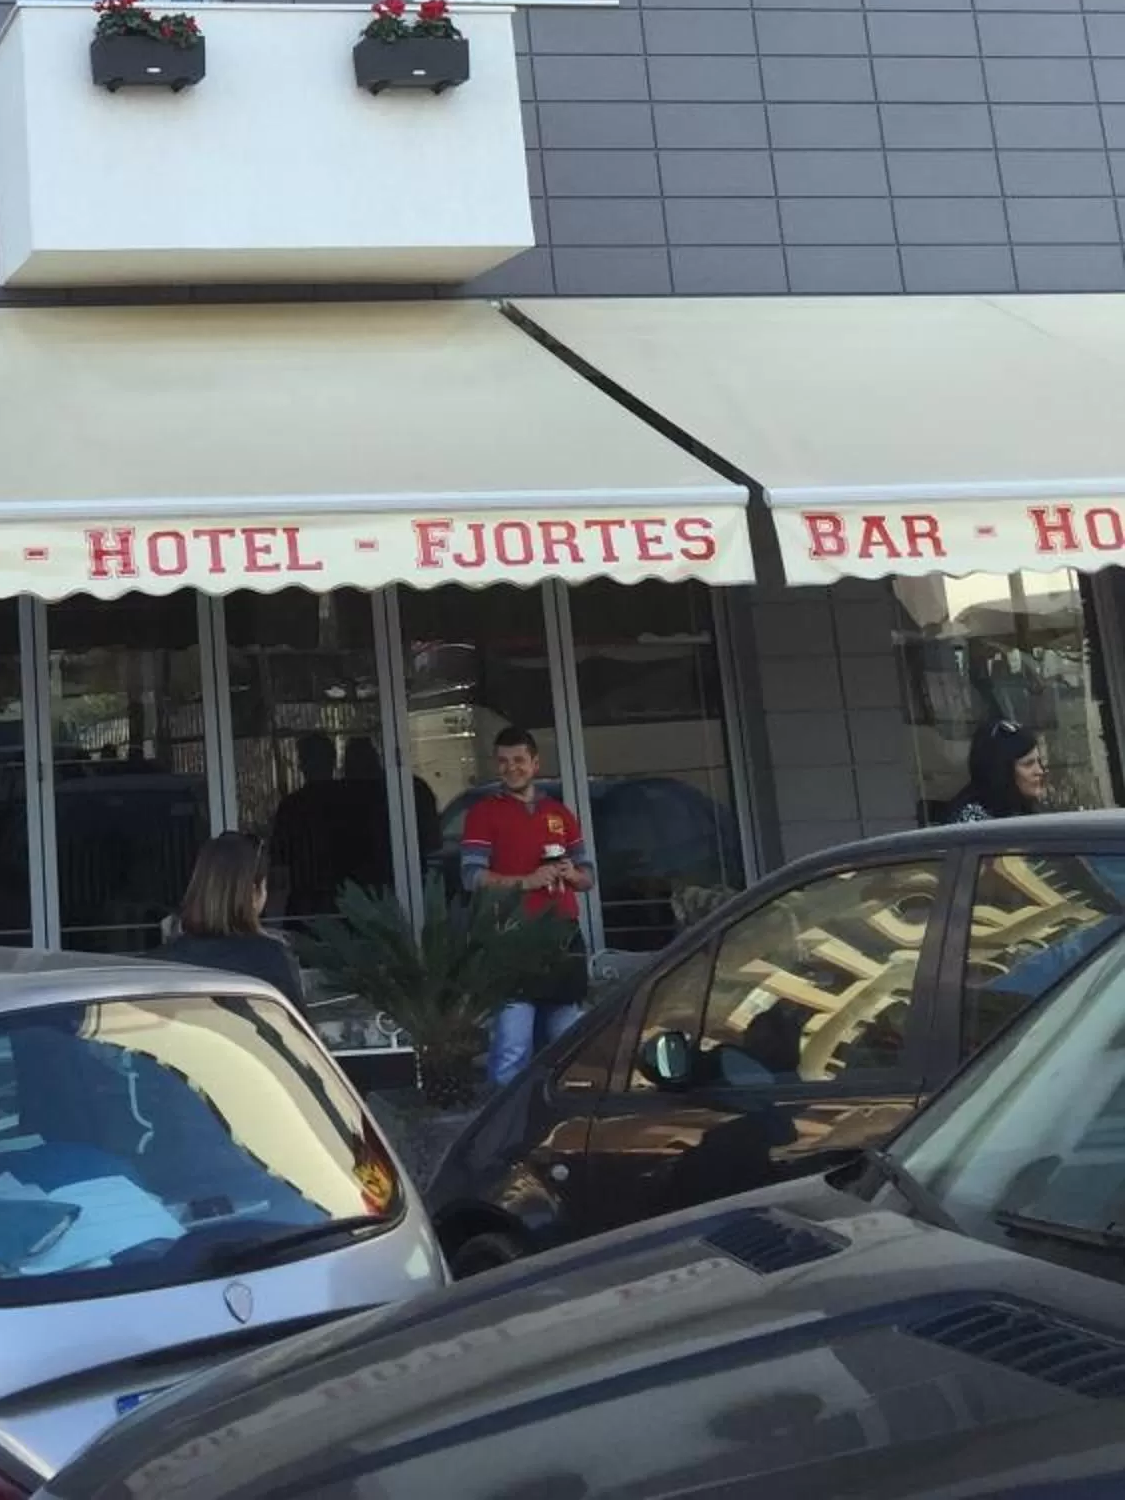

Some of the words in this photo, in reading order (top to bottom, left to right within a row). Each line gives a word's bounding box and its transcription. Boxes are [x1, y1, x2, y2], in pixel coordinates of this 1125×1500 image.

[84, 527, 325, 580] HOTEL
[412, 516, 717, 569] FJORTES
[802, 511, 947, 560] BAR
